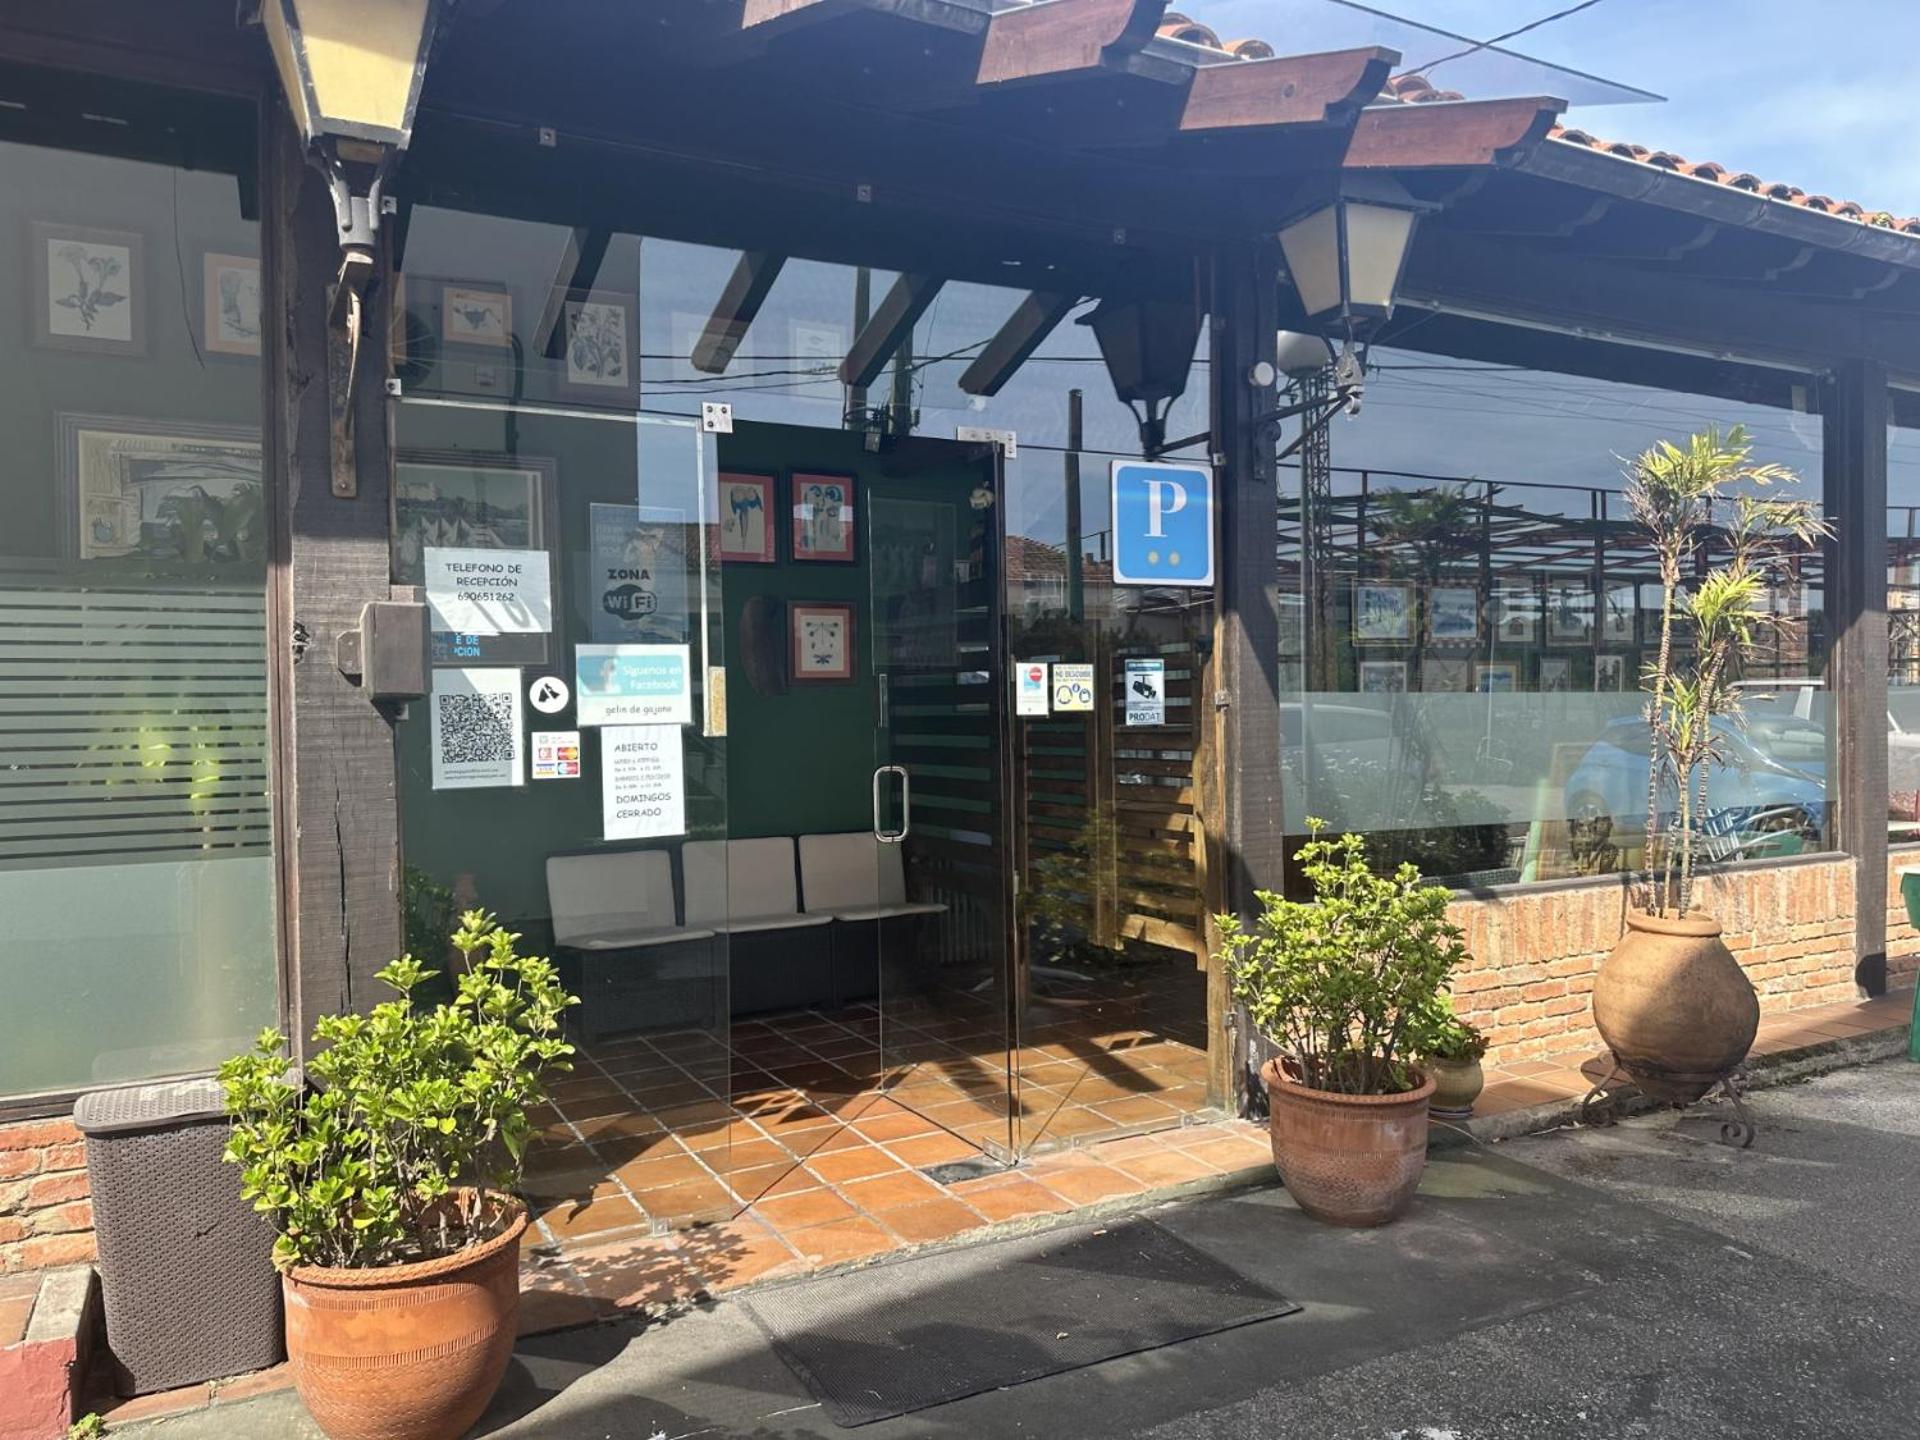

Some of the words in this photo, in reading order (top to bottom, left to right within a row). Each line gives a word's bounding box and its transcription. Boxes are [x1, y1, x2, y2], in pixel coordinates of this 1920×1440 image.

[1142, 479, 1188, 538] P
[445, 563, 504, 573] TELEFONO
[507, 564, 523, 574] DE
[607, 568, 651, 580] ZONA
[456, 576, 518, 587] RECEPCIÓN
[465, 635, 480, 645] DE
[629, 705, 641, 714] de
[1128, 712, 1161, 722] PRODAT
[613, 743, 658, 752] ABIERTO
[616, 792, 672, 804] DOMINGOS
[616, 807, 662, 819] CERRADO
